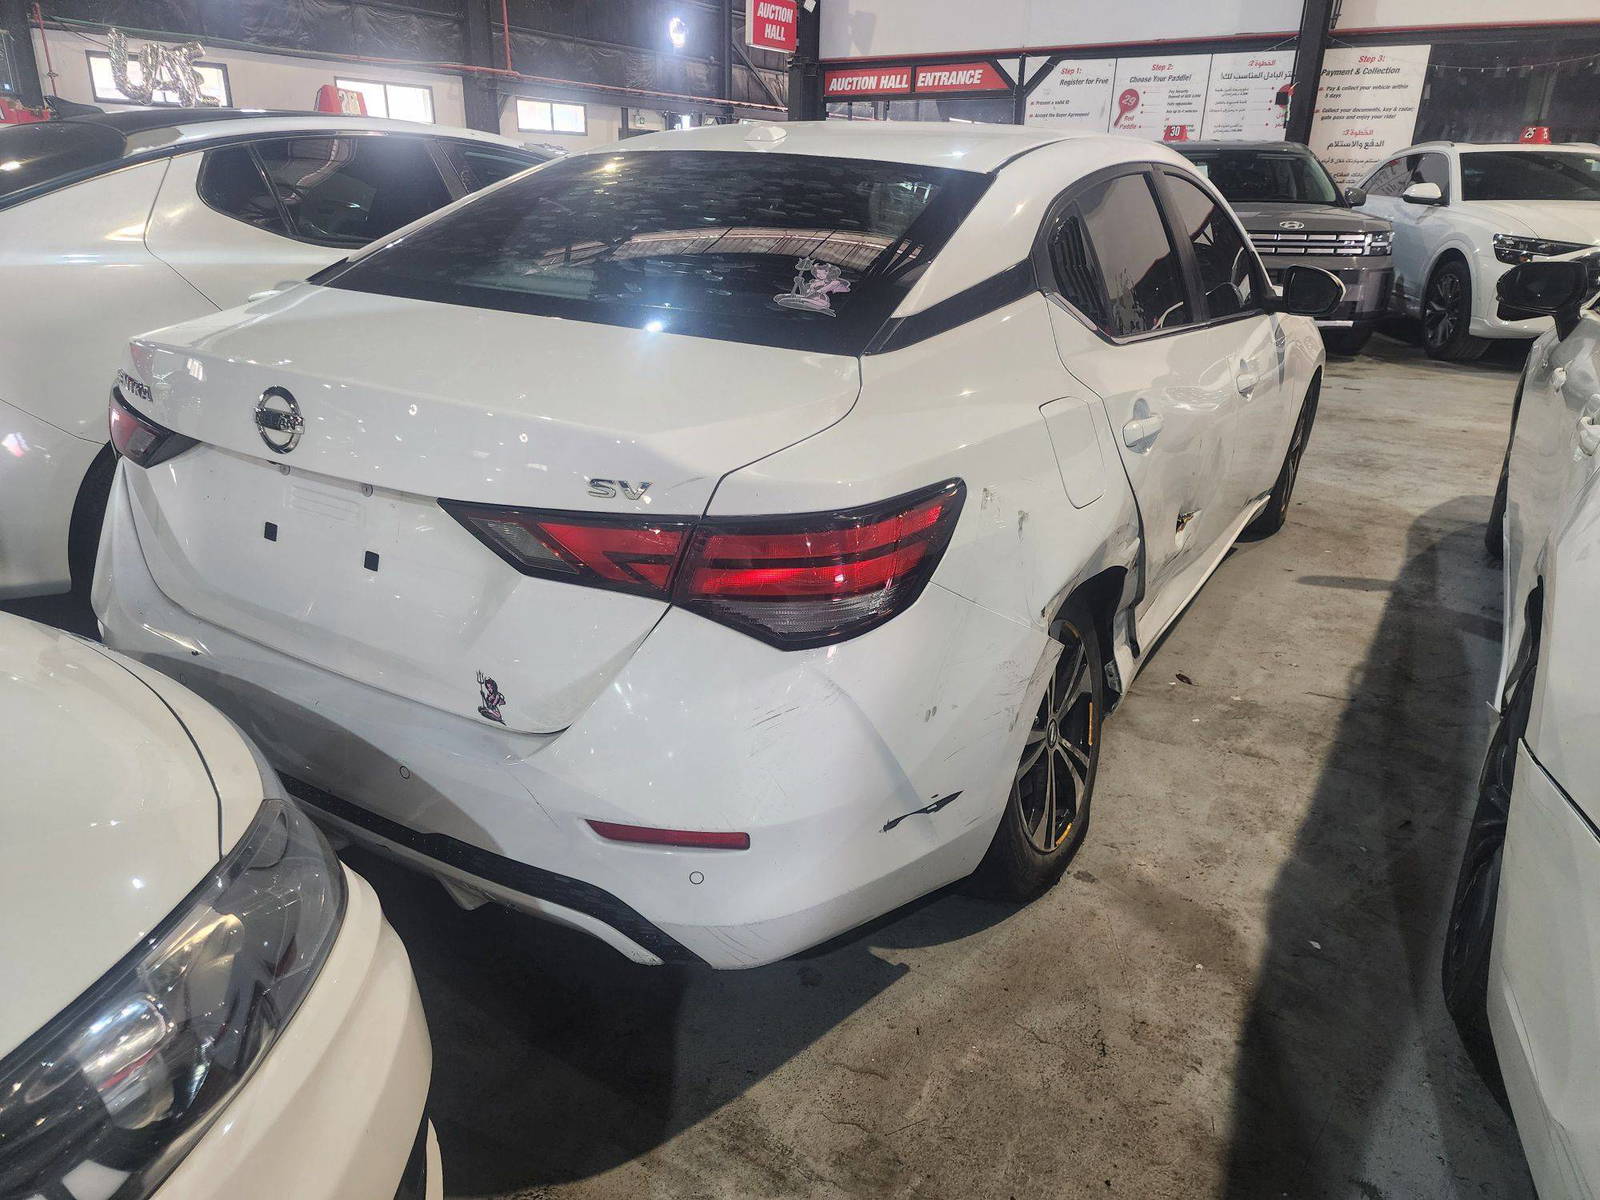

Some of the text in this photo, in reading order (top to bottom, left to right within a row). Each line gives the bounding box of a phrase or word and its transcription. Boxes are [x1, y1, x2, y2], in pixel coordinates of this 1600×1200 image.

[757, 4, 794, 24] AUCTION
[764, 23, 786, 42] HALL
[1358, 55, 1376, 63] Step
[1061, 68, 1075, 76] Step
[1152, 64, 1166, 72] Step
[1320, 68, 1354, 77] Payment
[1362, 67, 1401, 75] Collection
[829, 74, 909, 92] AUCTION HALL
[917, 69, 984, 87] ENTRANCE
[1060, 79, 1084, 87] Register
[1168, 74, 1192, 82] Paddle!
[1170, 126, 1180, 136] 30
[1327, 139, 1385, 150] الدفع والاستلام
[588, 478, 653, 500] SV
